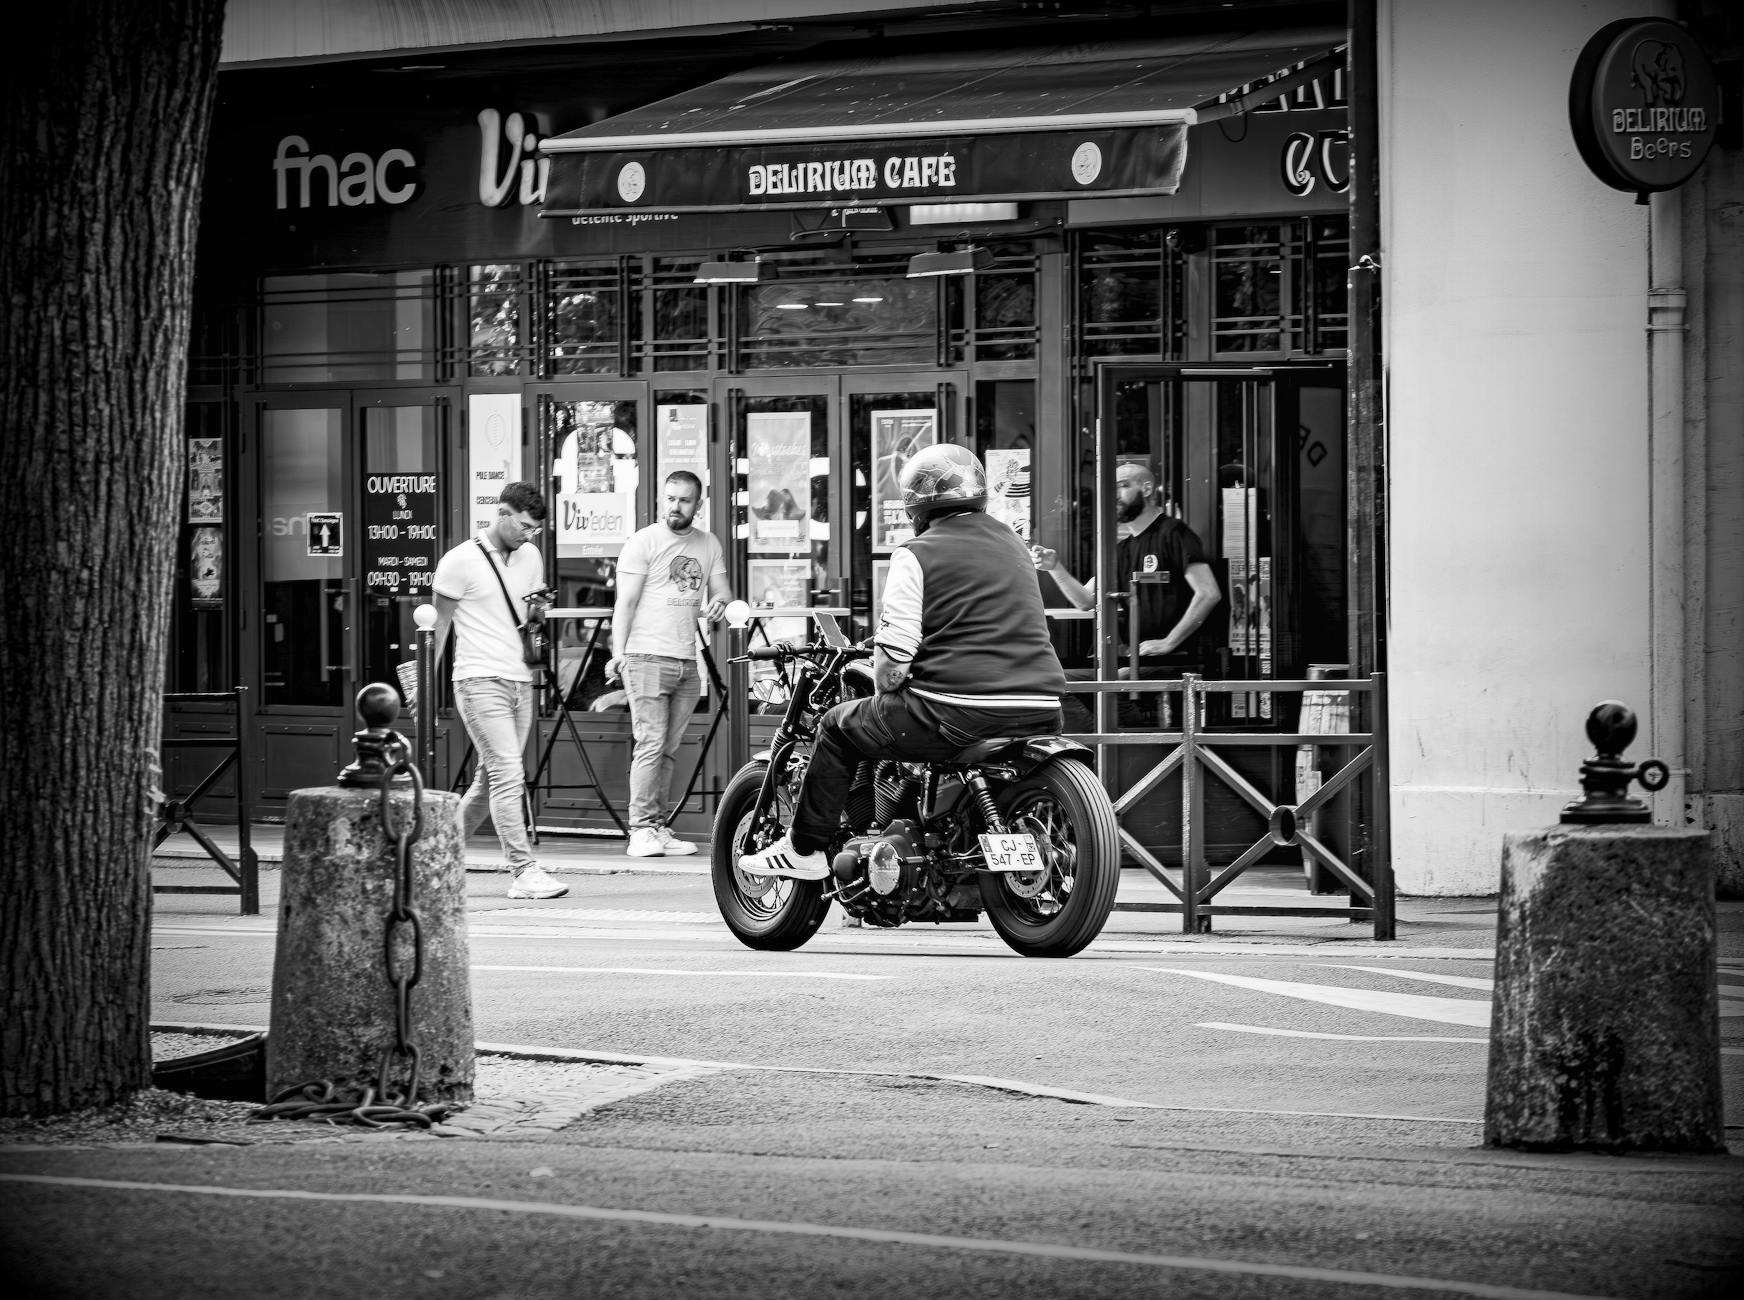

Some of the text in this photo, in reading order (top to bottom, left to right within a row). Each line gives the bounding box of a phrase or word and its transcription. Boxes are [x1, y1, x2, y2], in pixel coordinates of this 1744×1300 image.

[1612, 107, 1707, 133] DELIRIUM
[1630, 136, 1692, 160] Beers
[272, 135, 417, 210] fnac
[748, 152, 957, 196] DELIRIUM CAFÉ
[367, 476, 437, 493] OUVERTURE
[392, 510, 413, 520] LUNDI
[367, 525, 399, 540] 13H00
[367, 571, 400, 586] 09H30
